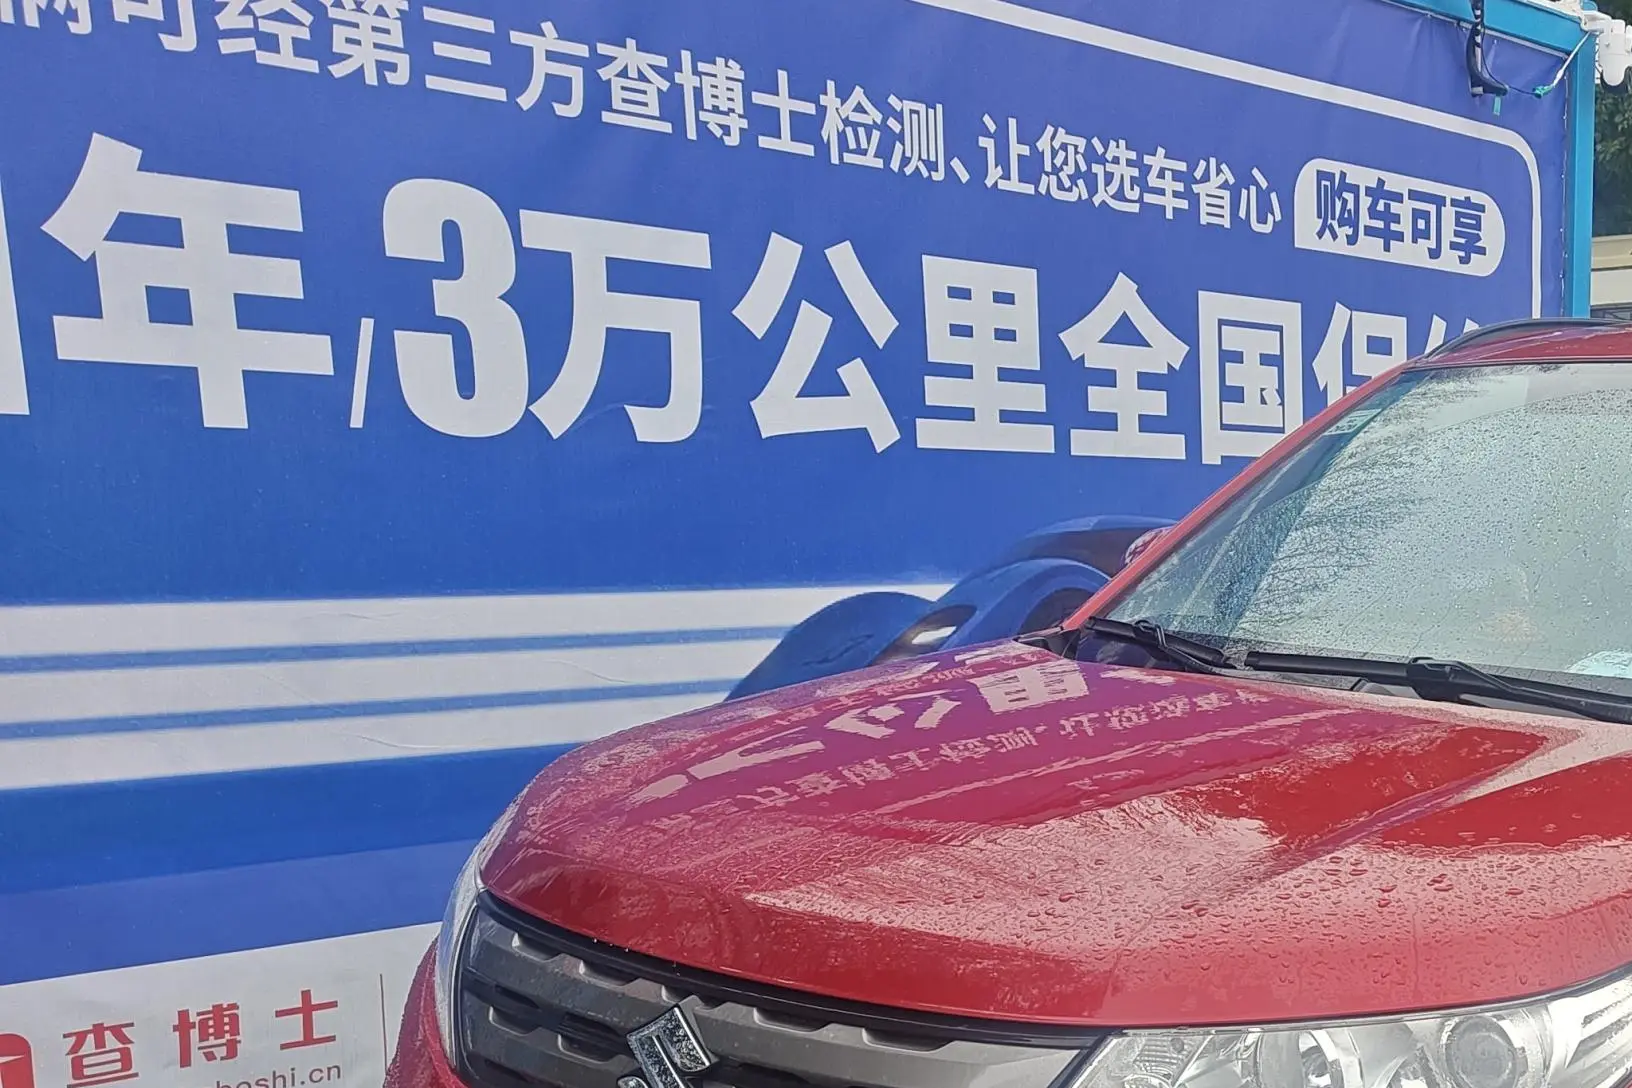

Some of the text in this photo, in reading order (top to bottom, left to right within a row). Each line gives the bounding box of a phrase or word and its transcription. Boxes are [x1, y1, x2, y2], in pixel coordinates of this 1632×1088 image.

[1316, 169, 1487, 265] 购车可享
[63, 989, 339, 1088] 查博士
